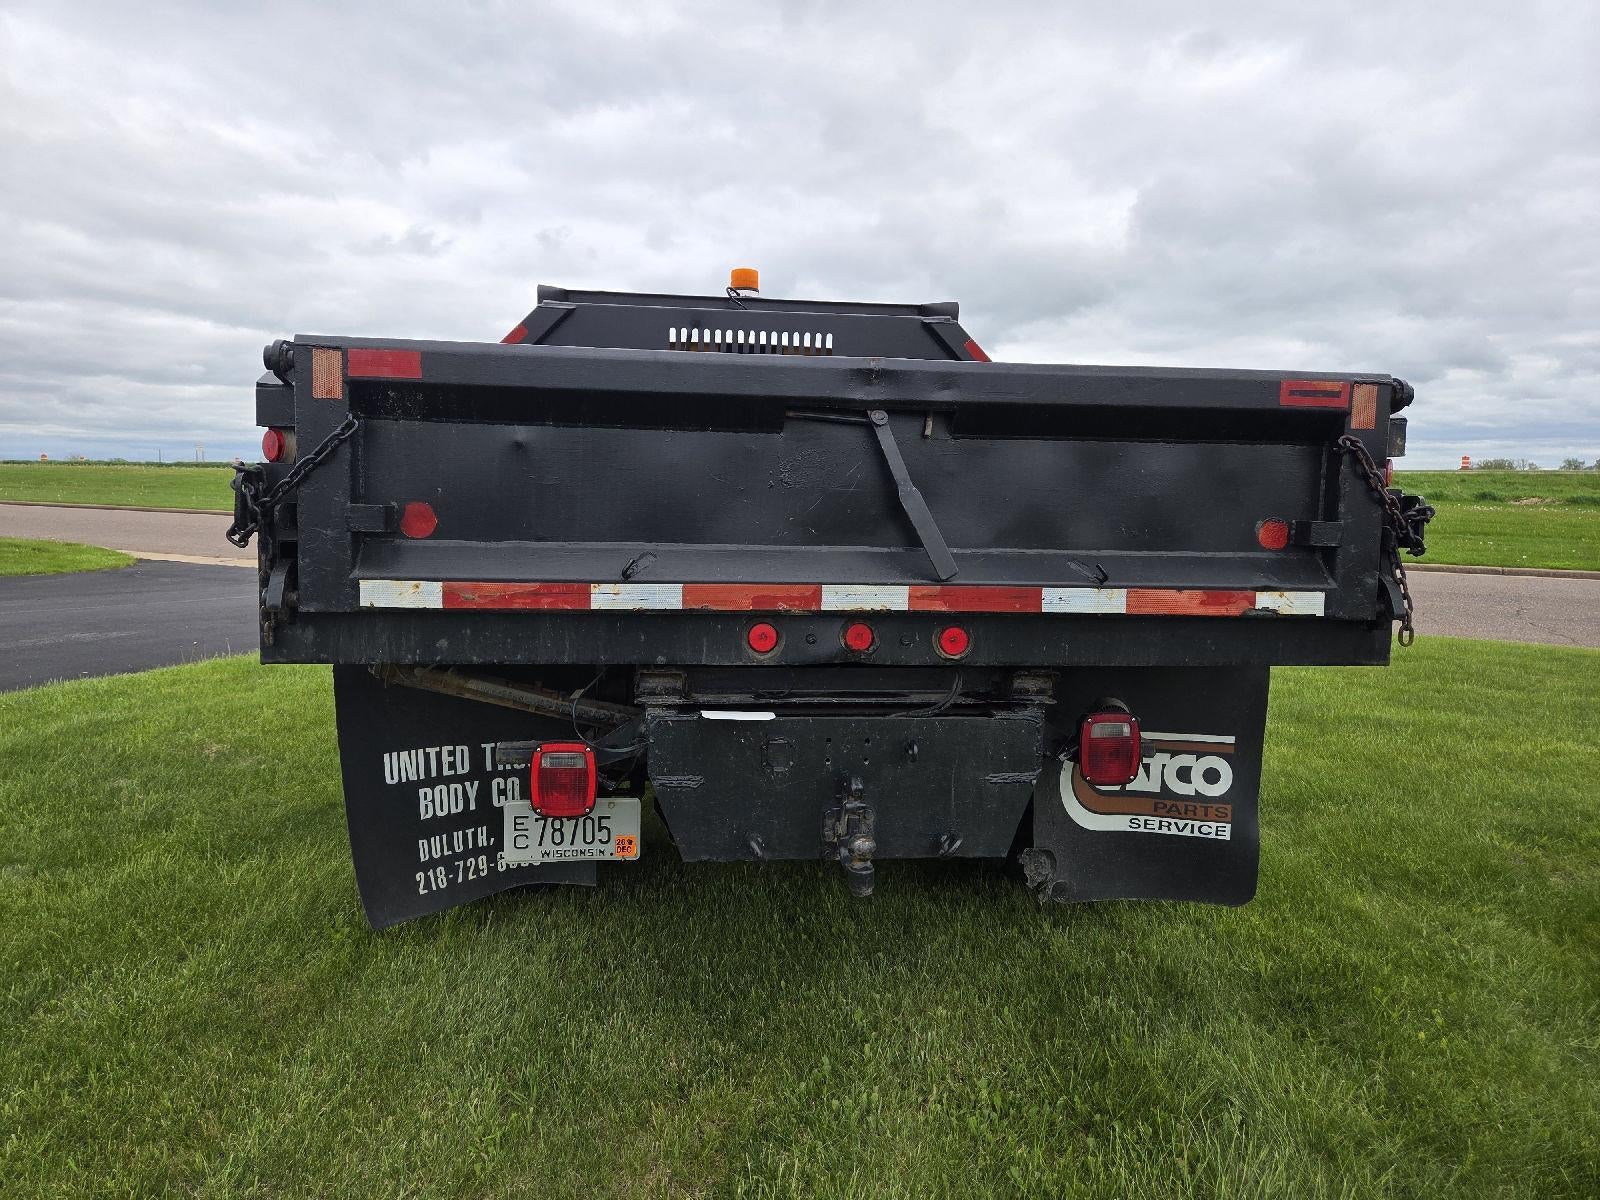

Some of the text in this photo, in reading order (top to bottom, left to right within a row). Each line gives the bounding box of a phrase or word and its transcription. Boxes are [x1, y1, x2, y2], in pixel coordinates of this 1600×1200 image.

[383, 745, 470, 785] UNITED
[418, 781, 479, 820] BODY
[1153, 801, 1229, 819] PARTS
[534, 815, 612, 847] 78705
[1128, 817, 1227, 837] SERVICE
[540, 848, 606, 858] WISCONSIN
[616, 845, 632, 854] DEC
